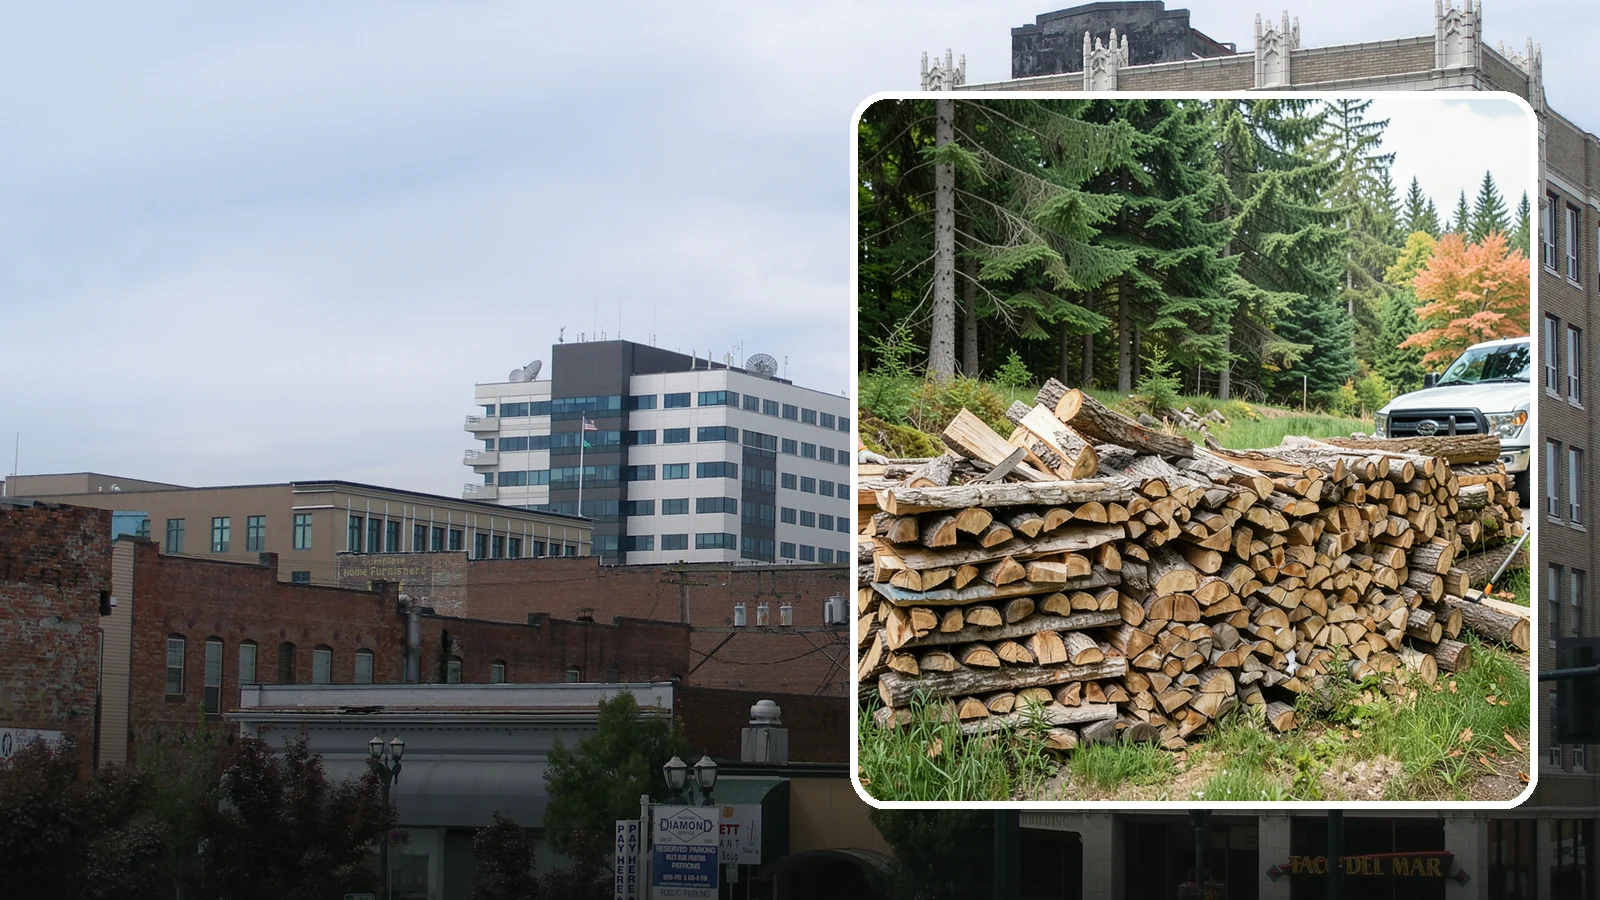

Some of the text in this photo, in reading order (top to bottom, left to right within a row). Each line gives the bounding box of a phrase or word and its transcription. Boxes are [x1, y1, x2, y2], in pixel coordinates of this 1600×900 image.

[343, 566, 427, 577] Home Furnishers
[660, 818, 713, 832] DIAMOND
[1022, 815, 1069, 828] BUILDING
[616, 825, 625, 893] PAY HERE
[627, 824, 636, 893] PAY HERE
[721, 851, 739, 862] Soup
[1290, 856, 1442, 876] TAC DEL MAR
[660, 888, 710, 898] PUBLIC PARKING
